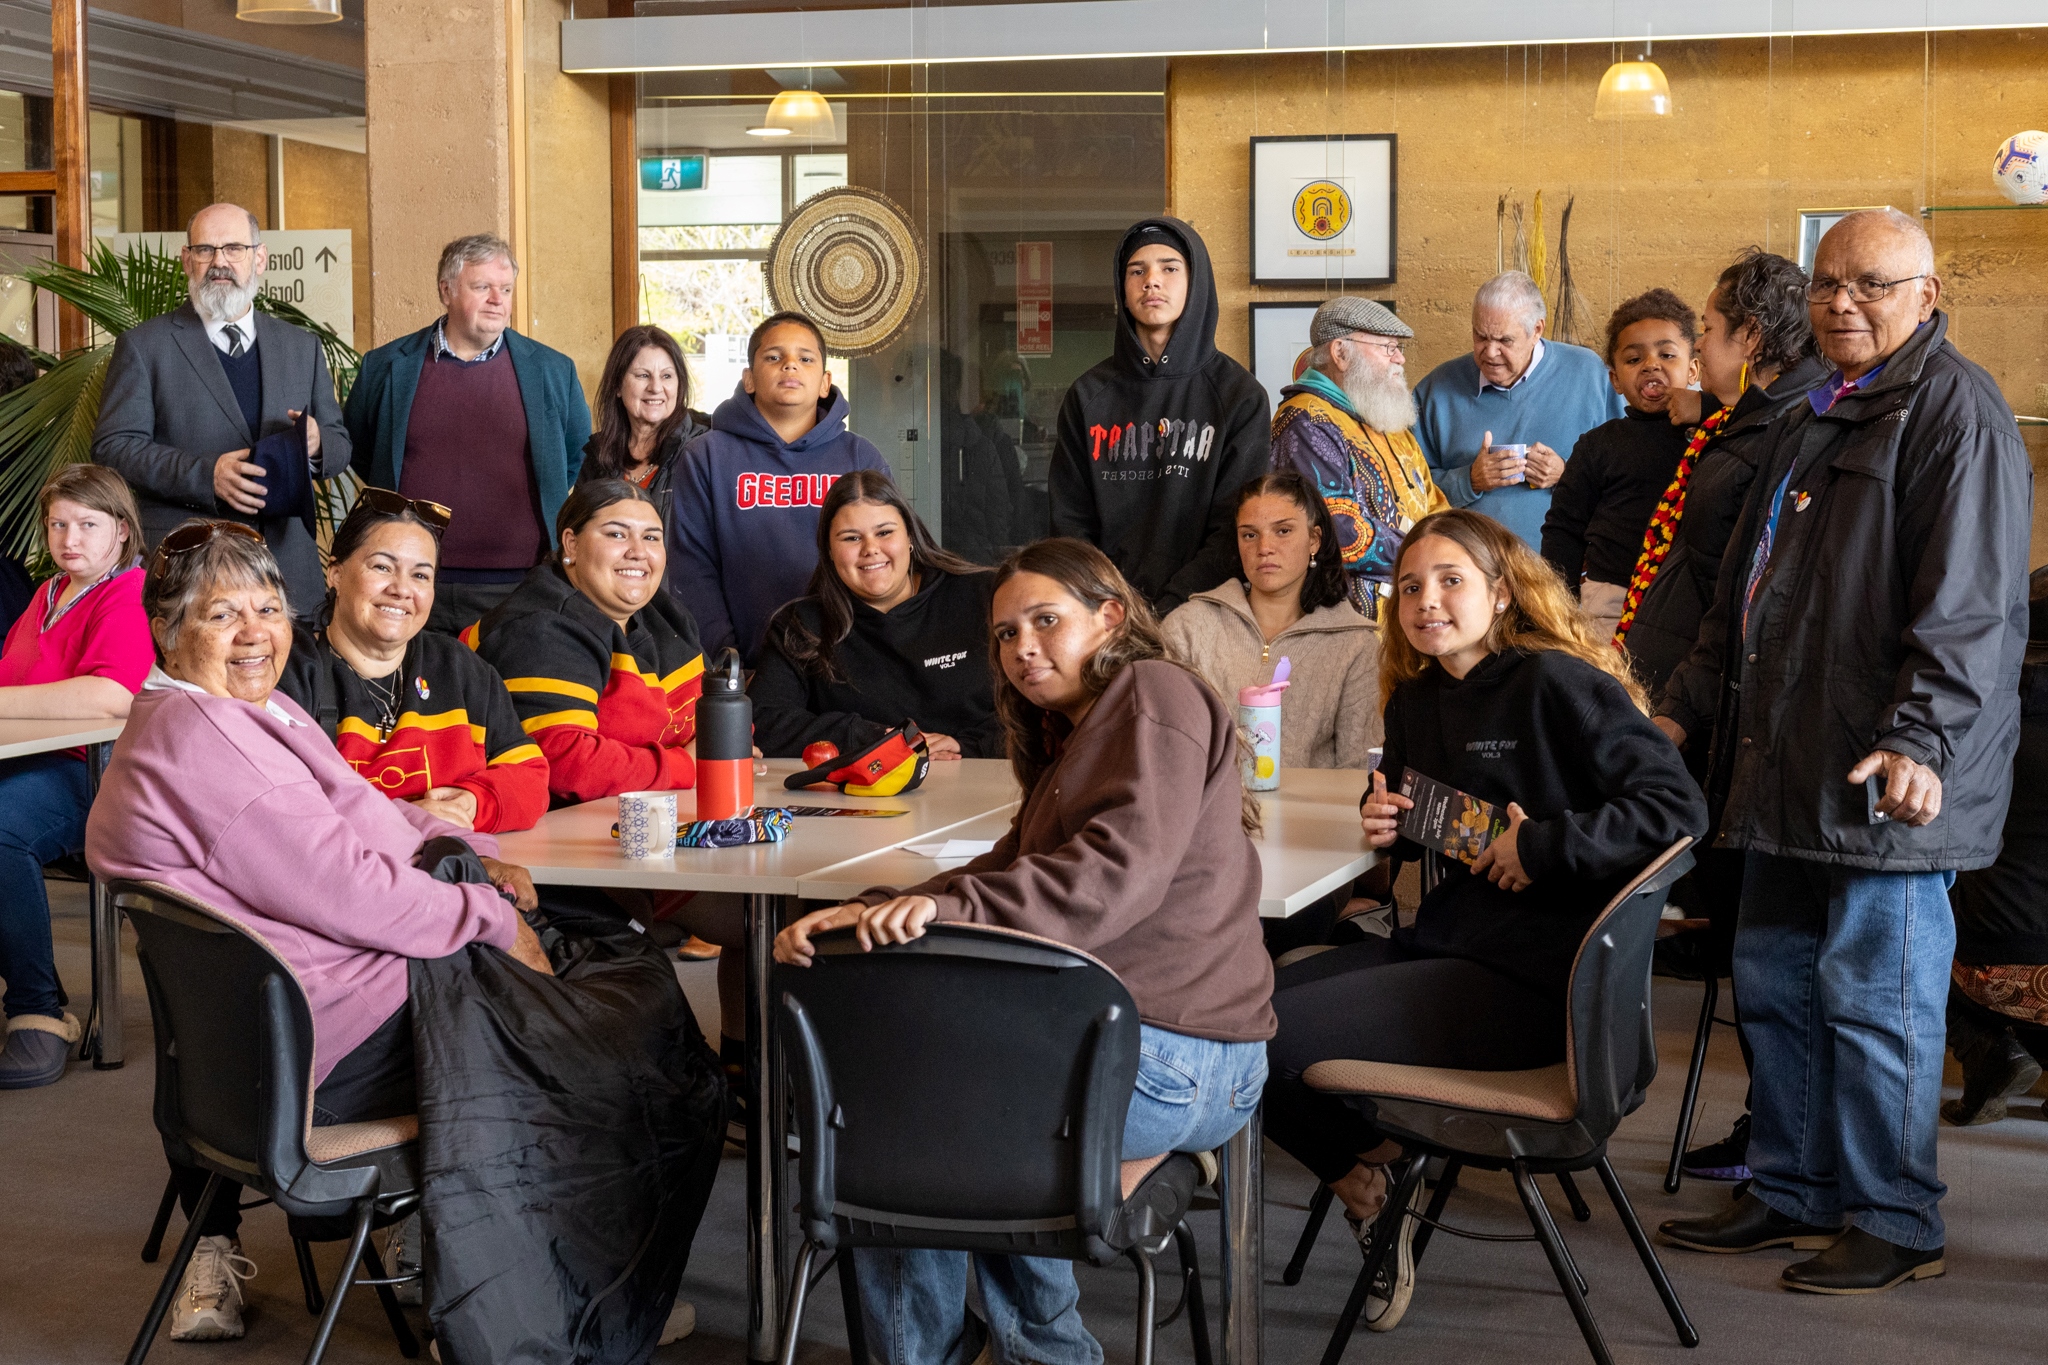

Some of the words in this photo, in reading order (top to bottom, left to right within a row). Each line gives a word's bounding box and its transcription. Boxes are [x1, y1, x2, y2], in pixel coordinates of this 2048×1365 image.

[924, 655, 951, 667] WHITE
[951, 650, 968, 661] FOX
[1465, 740, 1498, 751] WHITE
[1498, 740, 1518, 750] FOX
